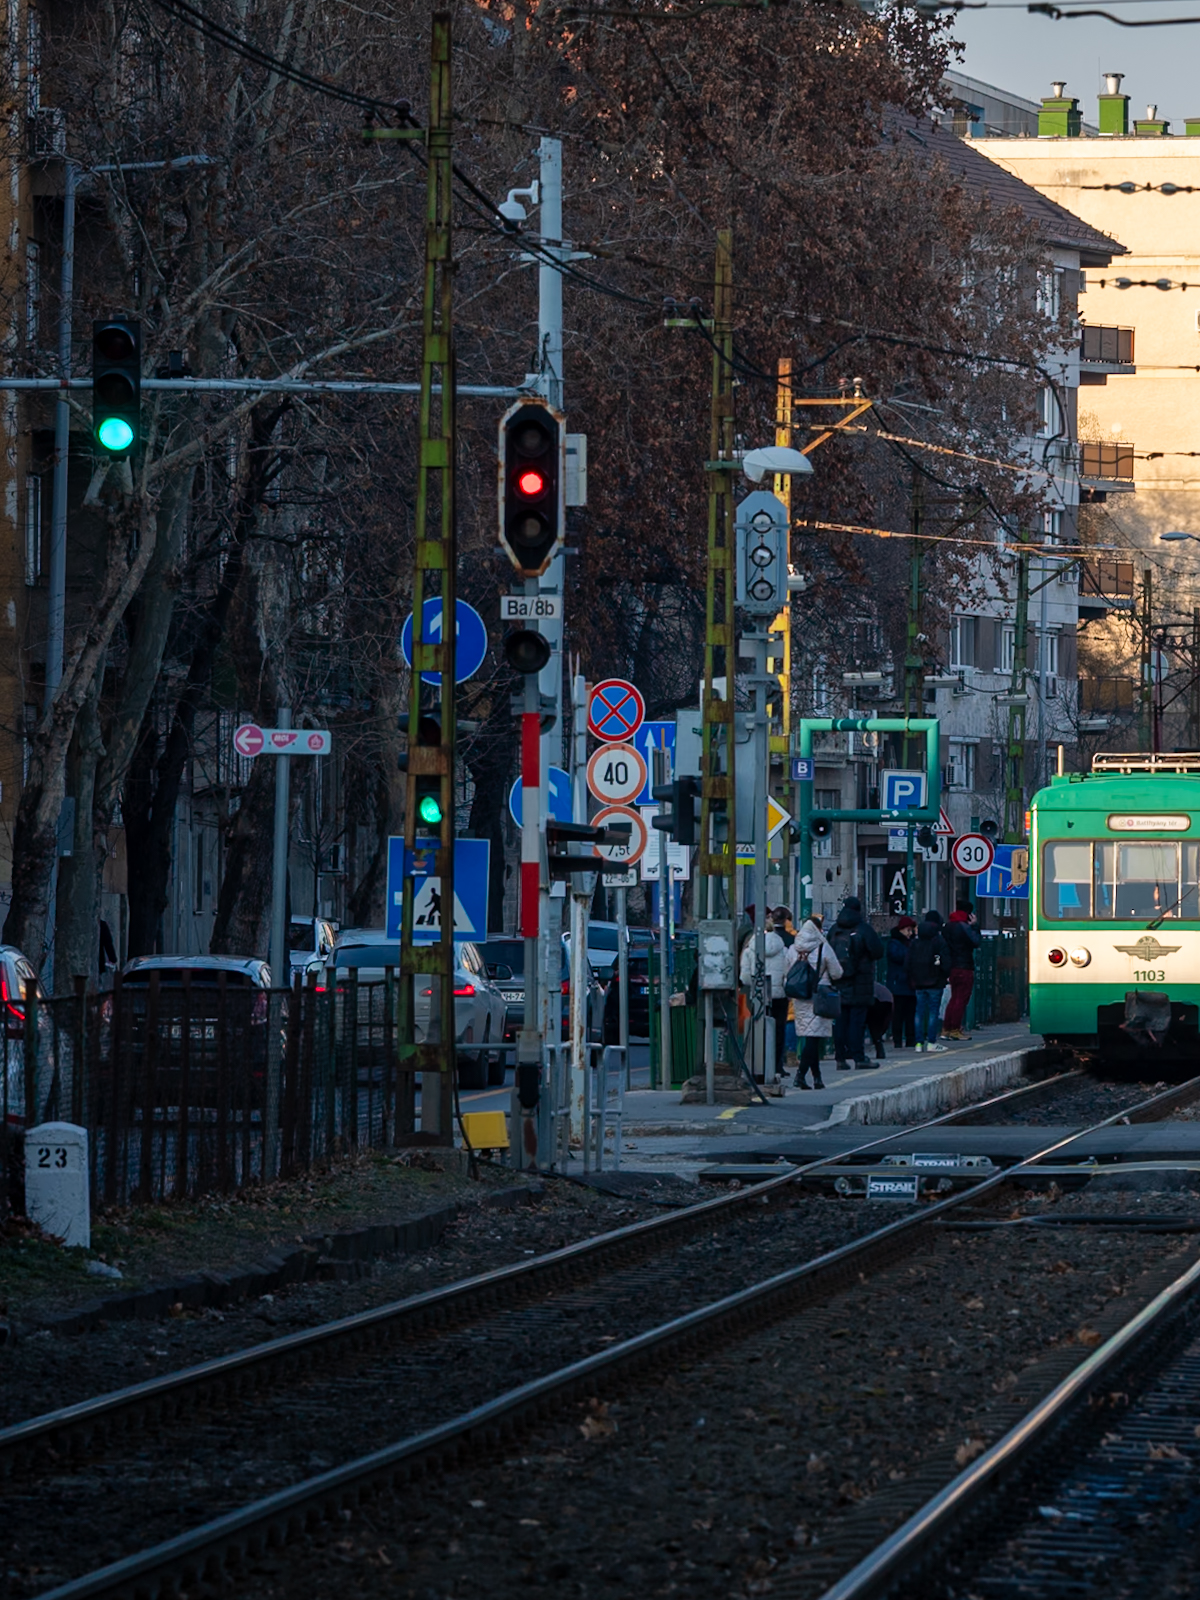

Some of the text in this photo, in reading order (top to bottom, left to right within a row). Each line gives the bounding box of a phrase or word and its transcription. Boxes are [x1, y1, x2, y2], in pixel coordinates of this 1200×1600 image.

[507, 600, 555, 617] Ba/8b
[603, 761, 628, 785] 40
[797, 761, 808, 774] B
[963, 846, 984, 862] 30
[1133, 970, 1165, 981] 1103
[38, 1147, 68, 1168] 23
[870, 1182, 915, 1193] STRAIL
